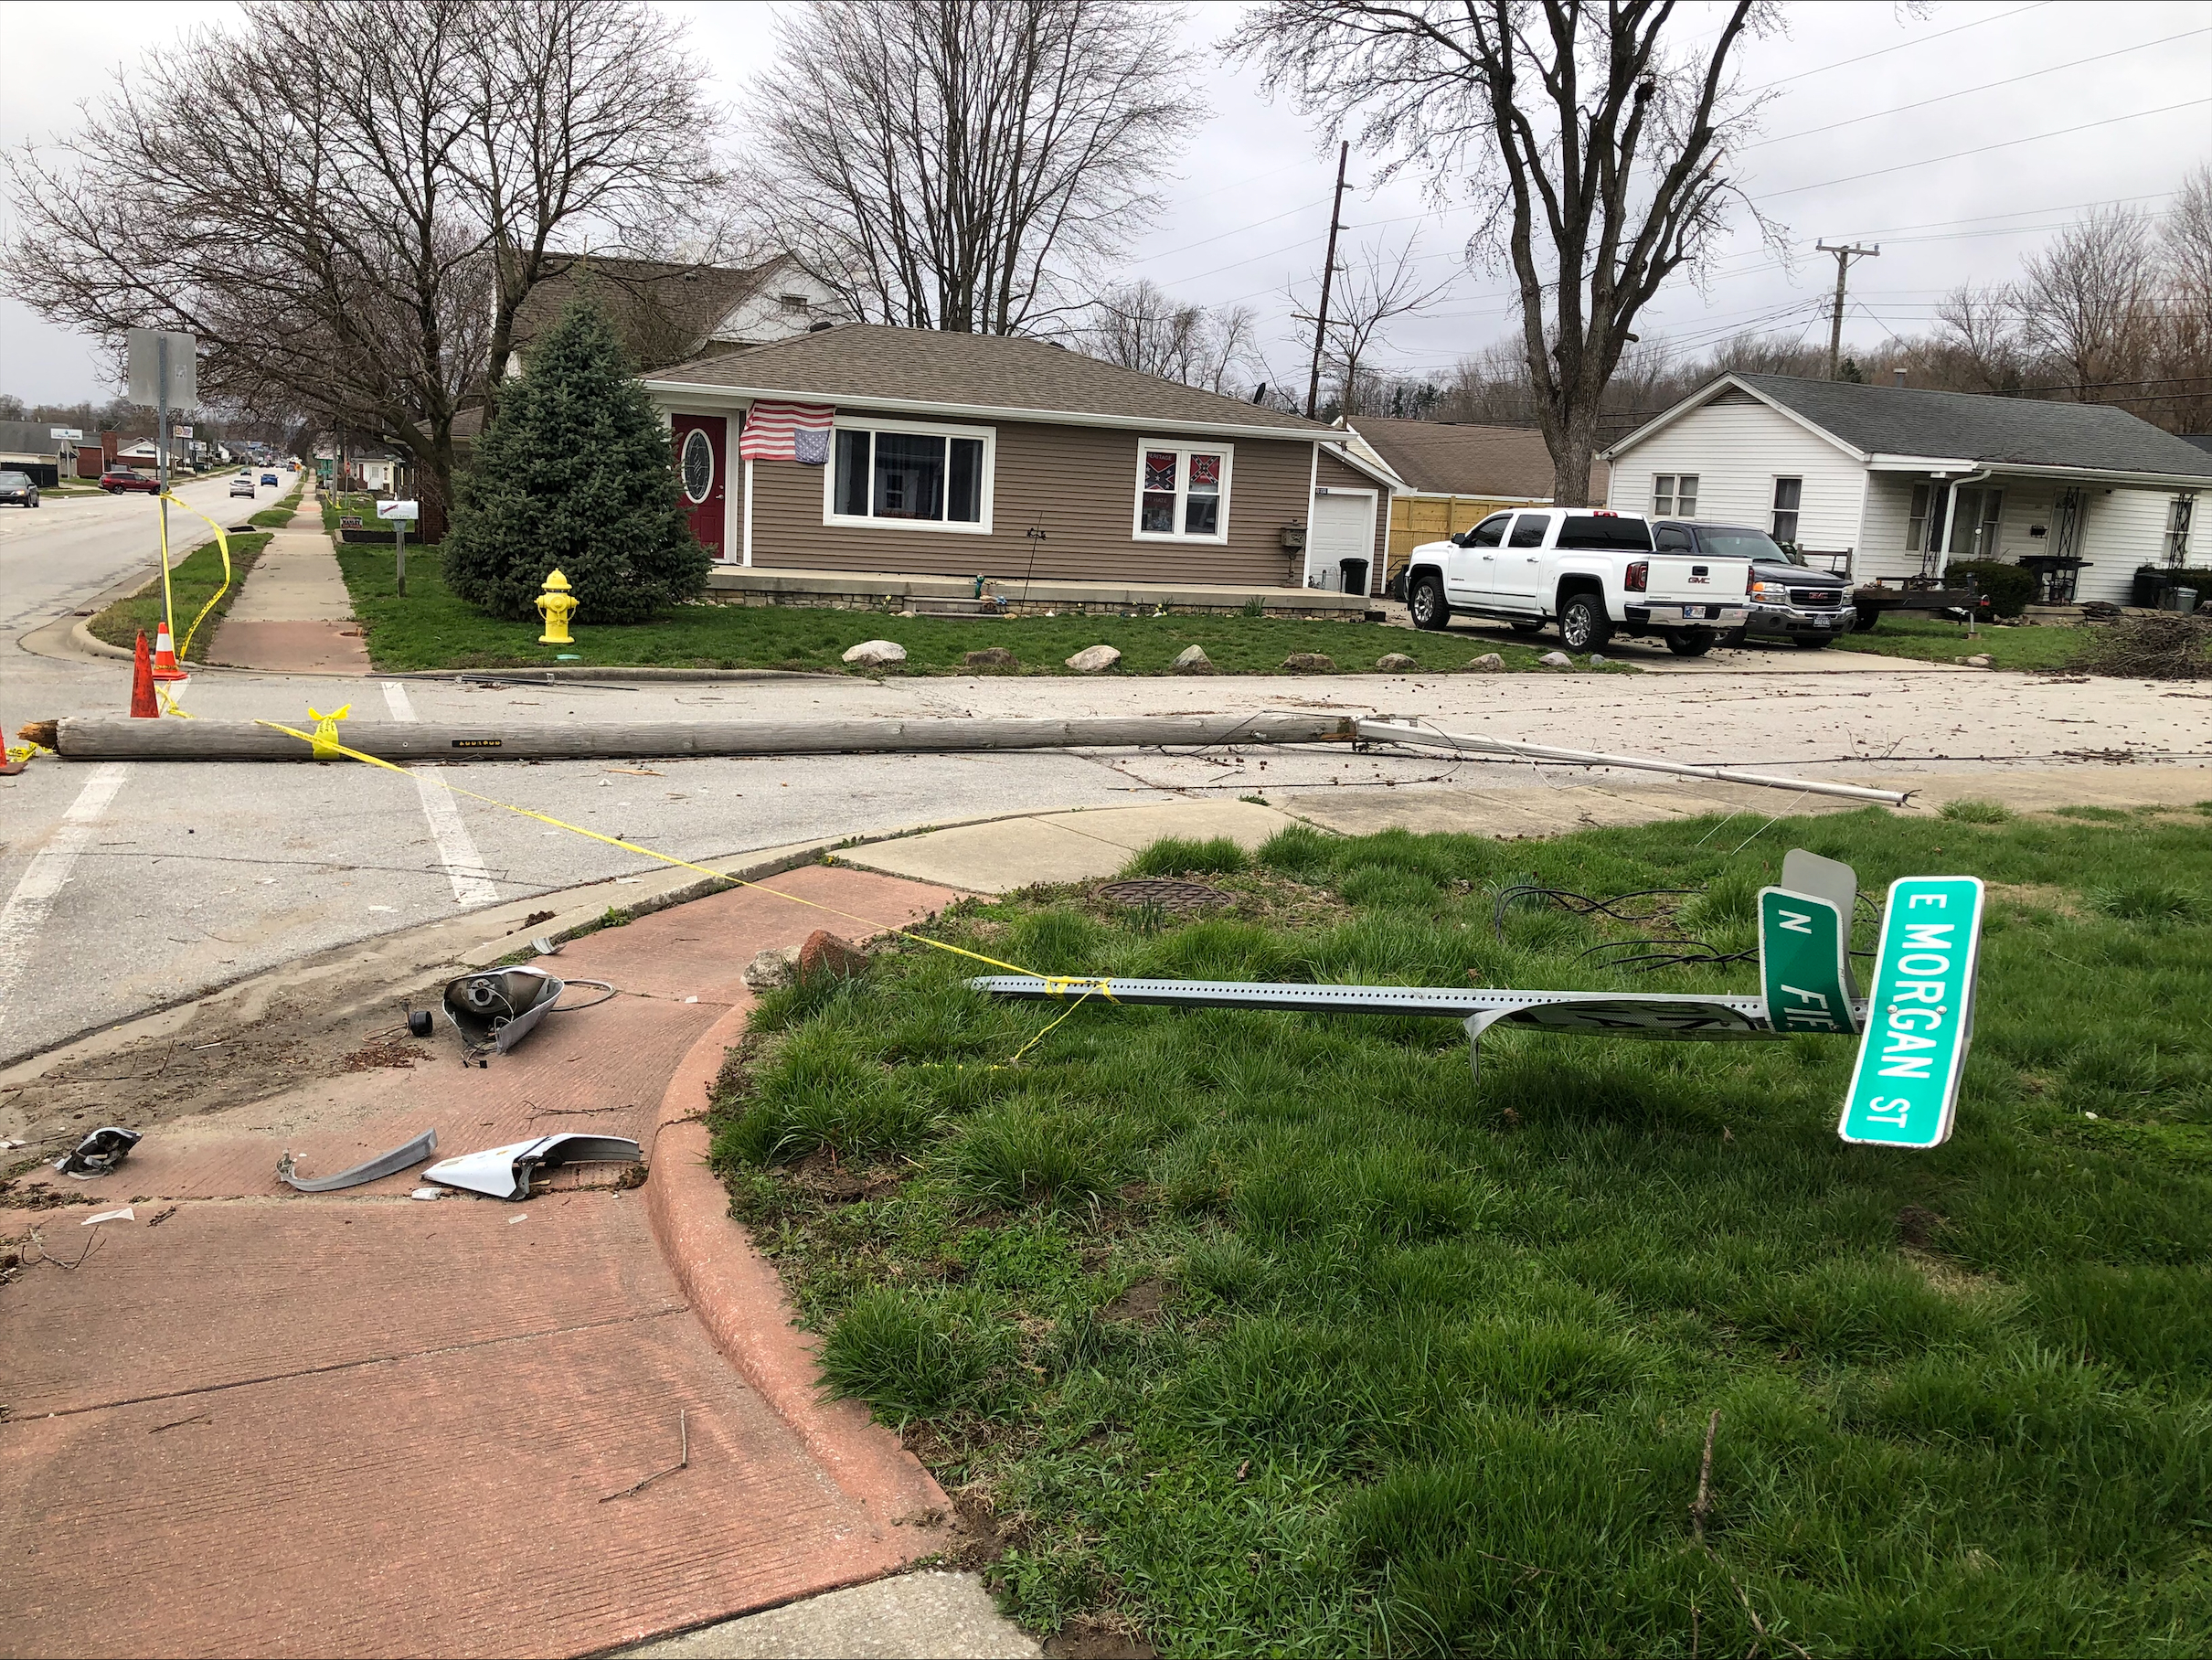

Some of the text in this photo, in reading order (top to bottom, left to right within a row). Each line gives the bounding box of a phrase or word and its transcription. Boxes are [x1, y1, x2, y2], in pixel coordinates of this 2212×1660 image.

[1778, 910, 1812, 934] N
[1866, 894, 1955, 1129] E MORGAN ST
